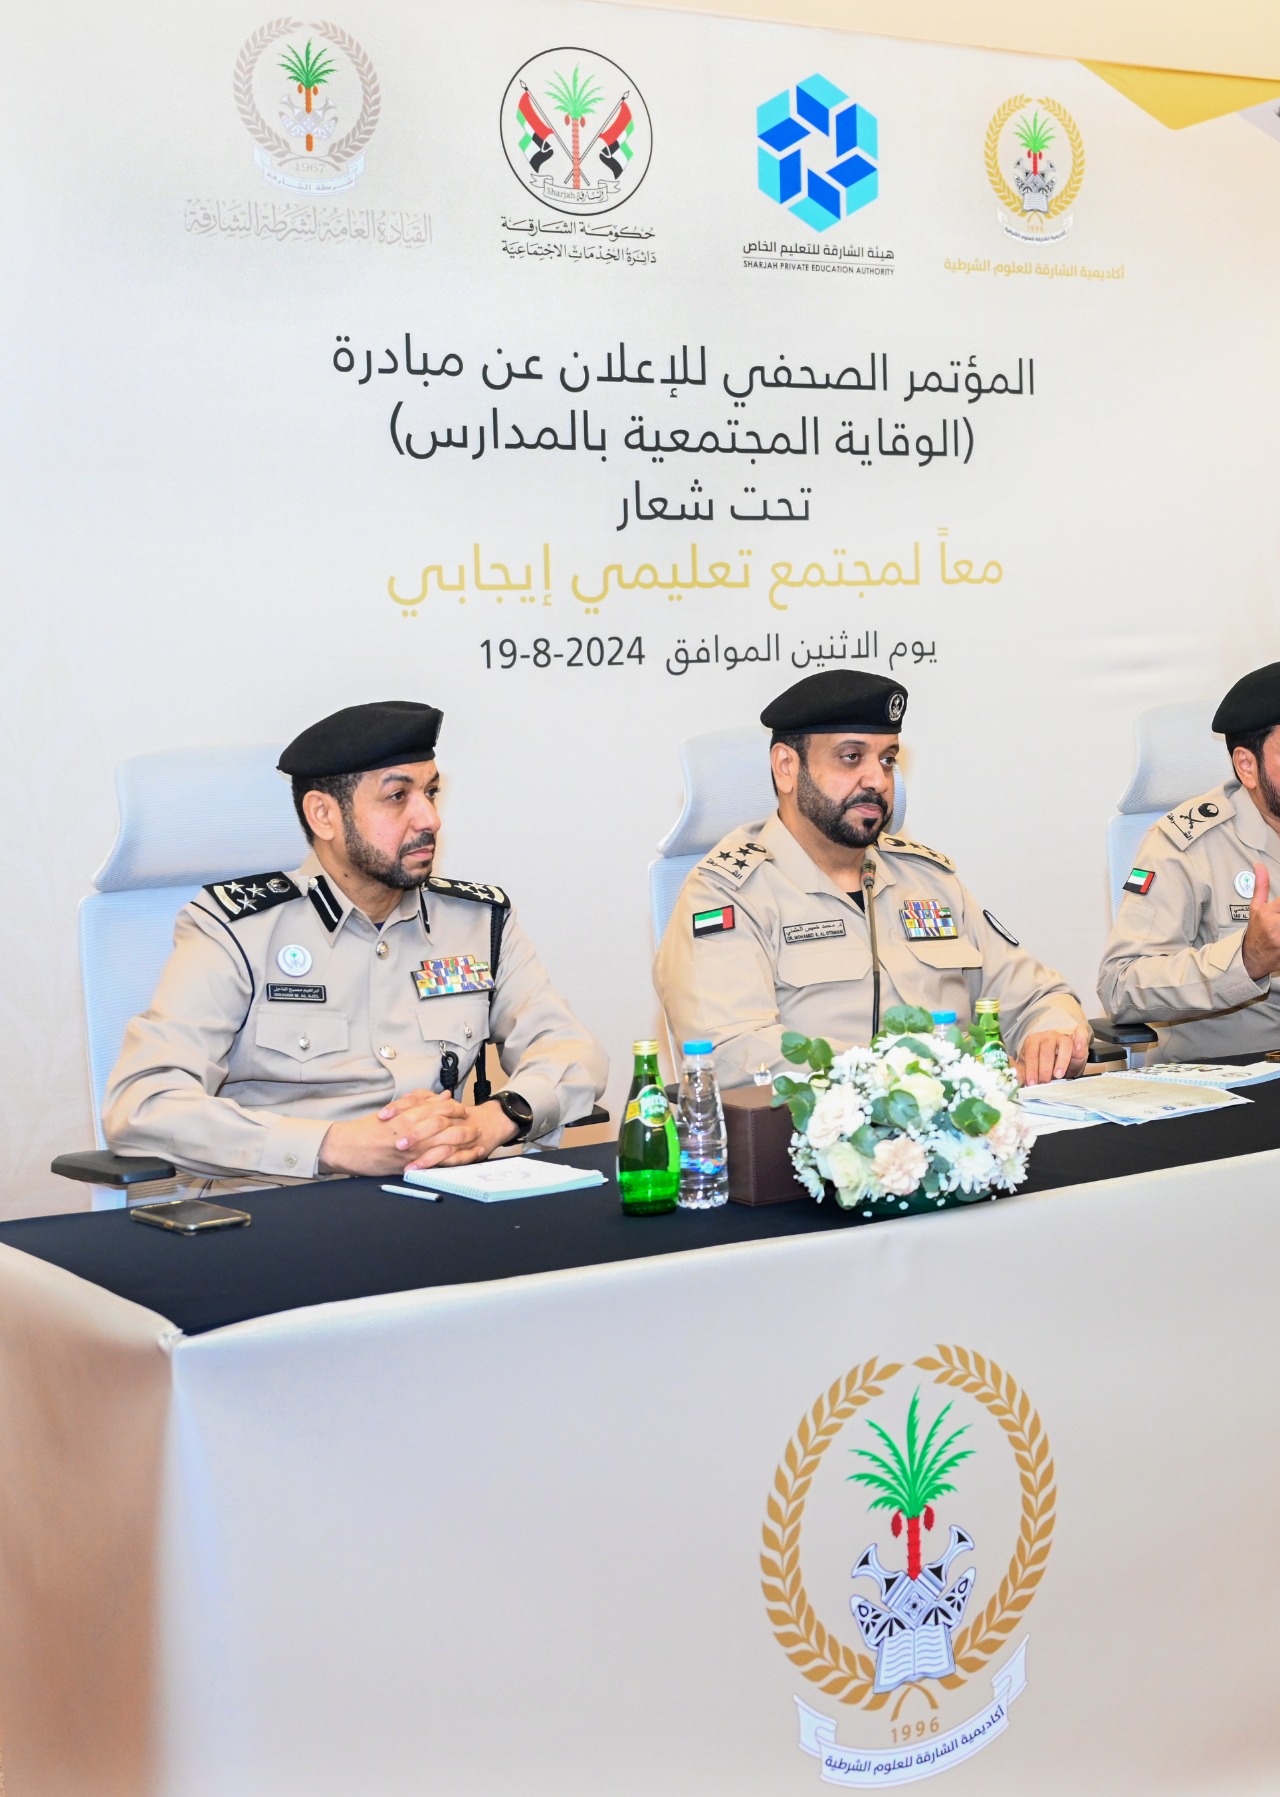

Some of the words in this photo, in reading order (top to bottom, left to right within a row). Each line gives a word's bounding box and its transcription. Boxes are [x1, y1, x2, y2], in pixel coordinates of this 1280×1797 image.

[296, 163, 325, 172] 1967
[547, 187, 575, 198] Sharjah
[501, 216, 576, 236] الشارقة
[579, 222, 656, 242] حكومة
[502, 240, 566, 260] الاجتماعية
[568, 246, 624, 264] الخدمات
[627, 248, 656, 266] دائرة
[743, 240, 776, 253] الخاص
[780, 243, 820, 256] للتعليم
[824, 244, 863, 259] الشارقة
[868, 246, 894, 261] هيئة
[744, 261, 778, 269] SHARJAH
[781, 263, 808, 271] PRIVATE
[812, 265, 854, 274] EDUCATION
[857, 267, 894, 275] AUTHORITY
[944, 258, 990, 274] الشرطية
[994, 261, 1032, 276] للعلوم
[1035, 263, 1077, 278] الشارقة
[1080, 265, 1125, 281] أكاديمية
[332, 332, 464, 384] مبادرة
[482, 348, 543, 389] عن
[560, 342, 706, 398] للإعلان
[723, 352, 889, 407] الصحفي
[903, 354, 1035, 403] المؤتمر
[389, 401, 608, 462] بالمدارس)
[623, 414, 818, 464] المجتمعية
[836, 416, 976, 465] (الوقاية
[616, 477, 714, 531] شعار
[730, 486, 812, 522] تحت
[937, 527, 1004, 586] معاً
[387, 542, 551, 617] إيجابي
[571, 543, 752, 615] تعليمي
[768, 541, 920, 610] لمجتمع
[479, 636, 646, 670] 19-8-2024
[665, 633, 780, 676] الموافق
[790, 632, 877, 668] الاثنين
[888, 637, 938, 671] يوم
[706, 857, 743, 879] الشرطة
[891, 1717, 940, 1744] 1996
[961, 1704, 1005, 1744] أكاديمية
[825, 1755, 871, 1774] الشرطية
[916, 1739, 959, 1764] الشارقة
[873, 1756, 913, 1775] للعلوم
